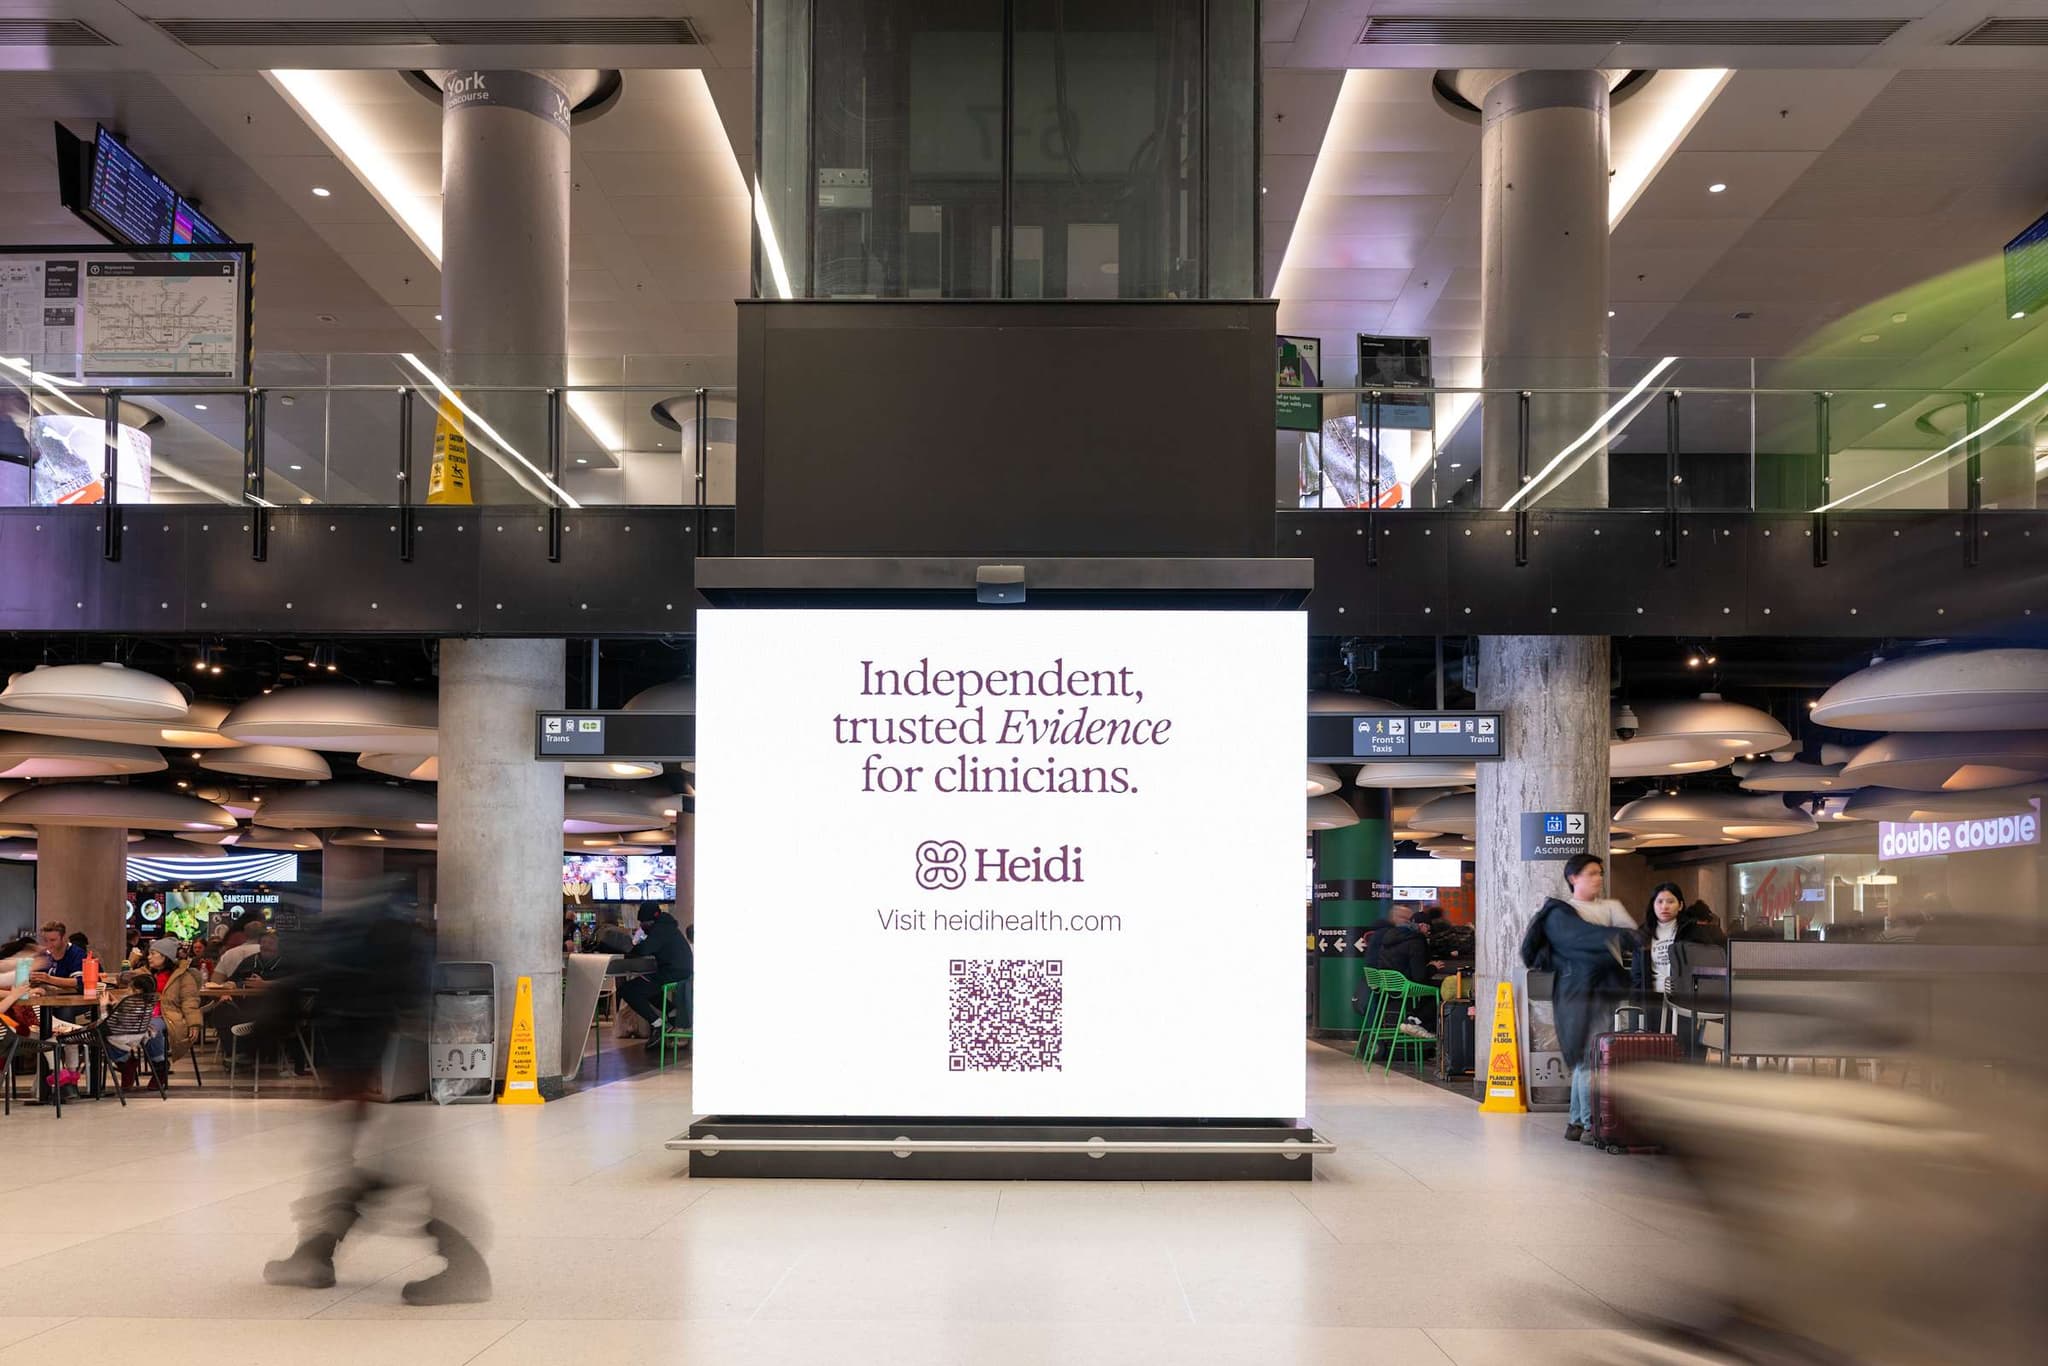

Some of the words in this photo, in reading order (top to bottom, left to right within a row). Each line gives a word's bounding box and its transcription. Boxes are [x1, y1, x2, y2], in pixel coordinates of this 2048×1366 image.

[447, 71, 486, 97] York
[860, 657, 1143, 707] Independent,
[833, 706, 987, 745] trusted
[996, 708, 1172, 746] Evidence
[546, 735, 570, 743] Trains
[1372, 736, 1394, 744] Front
[1395, 736, 1405, 744] St
[1470, 736, 1494, 744] Trains
[1372, 745, 1393, 753] Taxis
[862, 754, 923, 792] for
[935, 755, 1138, 793] clinicians.
[1545, 836, 1584, 845] Elevator
[1883, 822, 1951, 857] double
[1955, 815, 2036, 849] double
[1534, 846, 1584, 855] Ascenseur
[975, 845, 1085, 883] Heidi
[223, 894, 255, 904] SANSOTEI
[256, 894, 279, 904] RAMEN
[878, 909, 926, 931] Visit
[935, 909, 1121, 932] heidihealth.com
